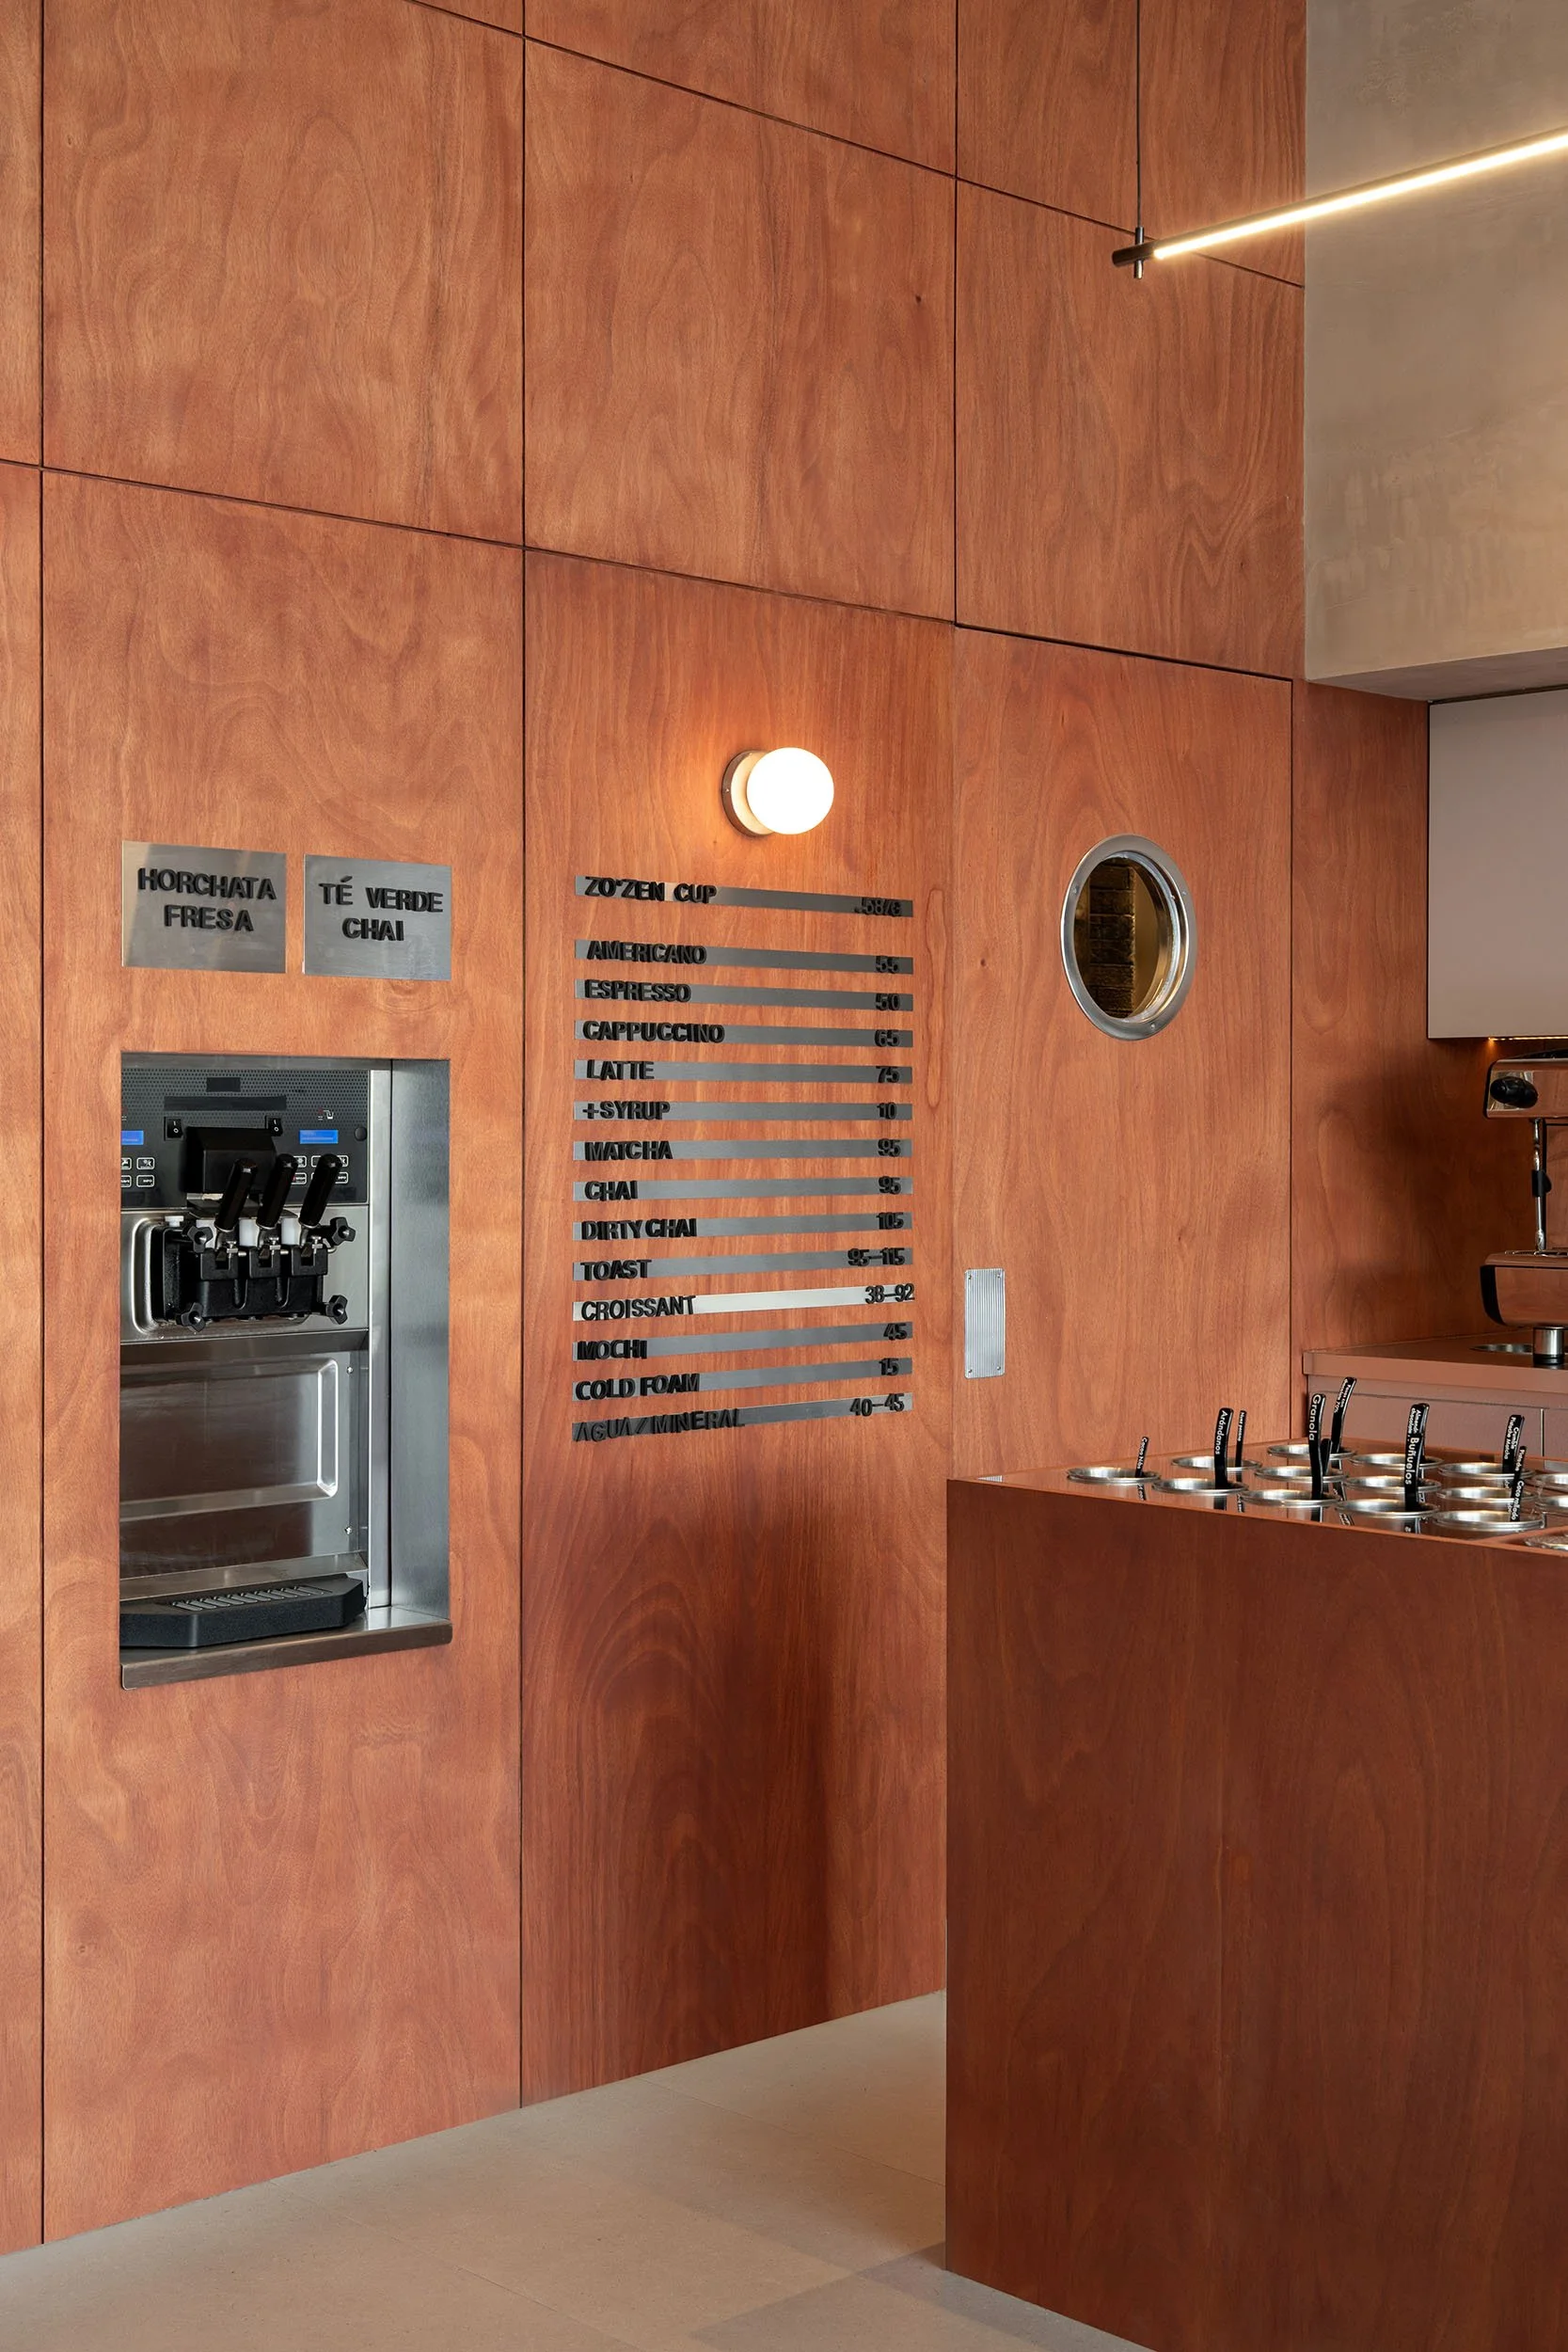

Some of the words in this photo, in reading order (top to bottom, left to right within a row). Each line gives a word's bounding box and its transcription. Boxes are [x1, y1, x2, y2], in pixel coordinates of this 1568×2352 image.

[137, 867, 277, 900] HORCHATA
[318, 875, 354, 906] TÉ
[365, 886, 444, 914] VERDE
[673, 882, 717, 903] CUP
[164, 904, 254, 932] FRESA
[341, 917, 404, 942] CHAI
[586, 941, 707, 965] AMERICANO
[875, 955, 899, 975] 55
[584, 978, 692, 1003] ESPRESSO
[875, 993, 901, 1011] 50
[582, 1020, 725, 1043] CAPPUCCINO
[874, 1029, 901, 1048] 65
[586, 1059, 655, 1081] LATTE
[876, 1065, 900, 1084] 75
[582, 1101, 671, 1120] +SYRUP
[877, 1102, 897, 1120] 10
[584, 1140, 673, 1161] MATCHA
[878, 1138, 901, 1157] 95
[584, 1180, 639, 1201] CHAI
[878, 1176, 901, 1195] 95
[581, 1220, 643, 1241] DIRTY
[644, 1218, 698, 1237] CHAI
[876, 1212, 904, 1231] 105
[580, 1259, 652, 1281] TOAST
[581, 1295, 696, 1321] CROISSANT
[578, 1339, 648, 1360] MOCHI
[883, 1322, 908, 1342] 45
[575, 1377, 636, 1401] COLD
[640, 1373, 700, 1396] FOAM
[879, 1358, 899, 1376] 15
[1308, 1394, 1322, 1441] Granola
[1214, 1409, 1228, 1455] Arándanos
[1510, 1426, 1519, 1450] Crumble
[1404, 1437, 1420, 1486] Buñuelos
[1503, 1438, 1512, 1460] Matcha
[1514, 1480, 1525, 1498] Coco
